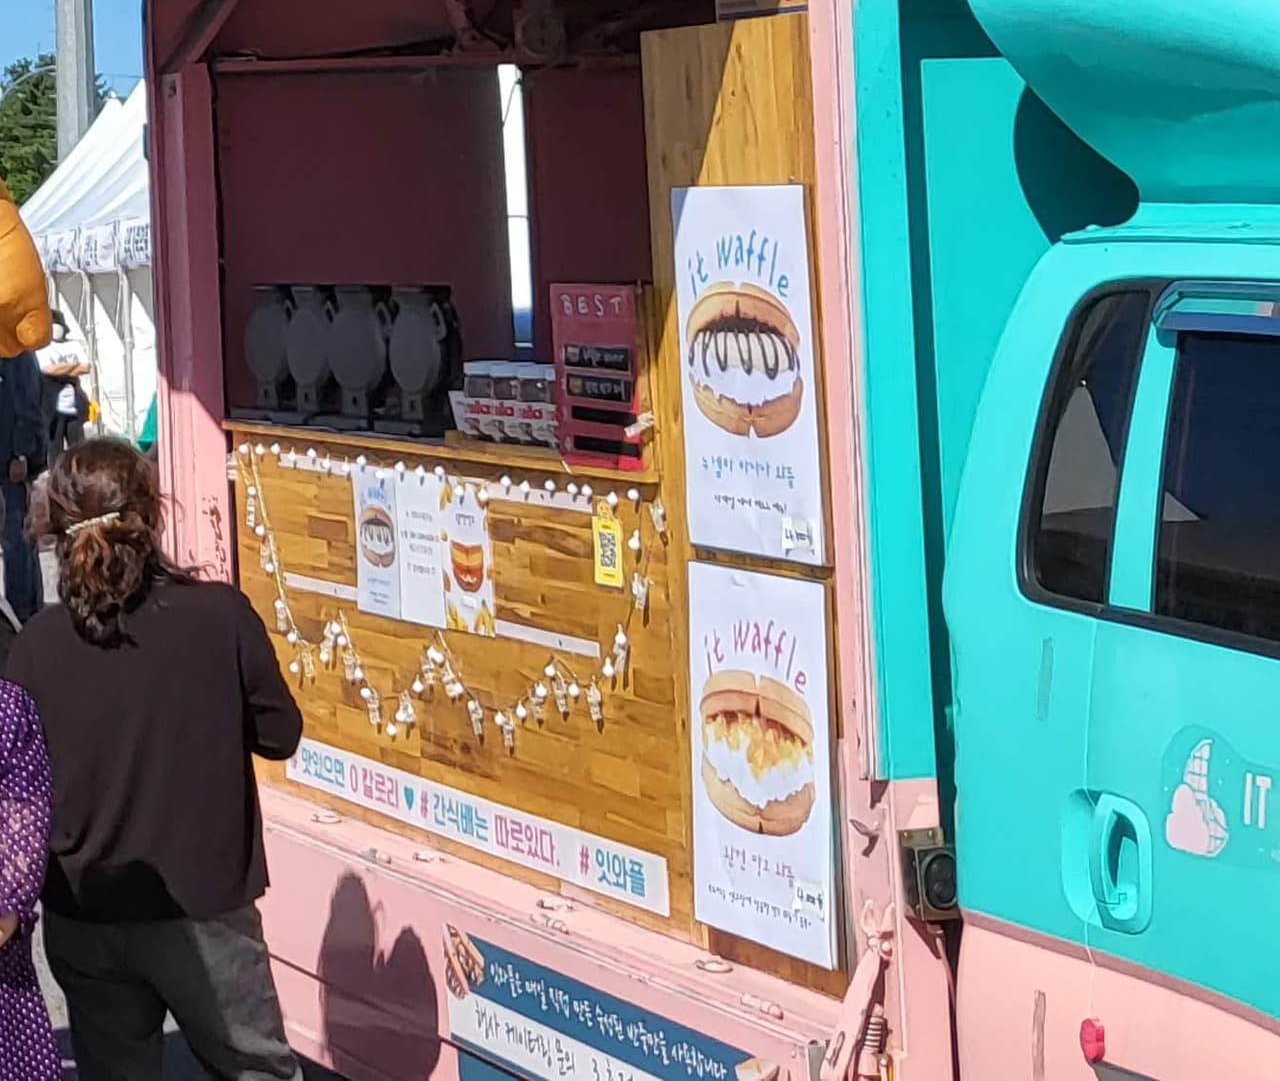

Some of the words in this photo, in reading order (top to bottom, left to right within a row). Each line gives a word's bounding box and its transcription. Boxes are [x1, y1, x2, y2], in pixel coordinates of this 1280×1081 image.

[688, 250, 709, 299] it
[716, 229, 789, 299] waffle
[560, 294, 623, 317] BEST
[704, 628, 725, 674] it
[733, 618, 808, 695] waffle
[301, 747, 345, 788] 맛있으면
[362, 767, 399, 808] 칼로리
[494, 814, 561, 867] 따로있다.
[595, 847, 645, 898] 잇와플
[1244, 771, 1272, 830] IT
[475, 1000, 500, 1040] 행사
[505, 1022, 552, 1068] 케이터링
[555, 1038, 576, 1076] 문의
[525, 979, 548, 1011] 매일
[548, 987, 570, 1019] 직접
[573, 999, 593, 1028] 만든
